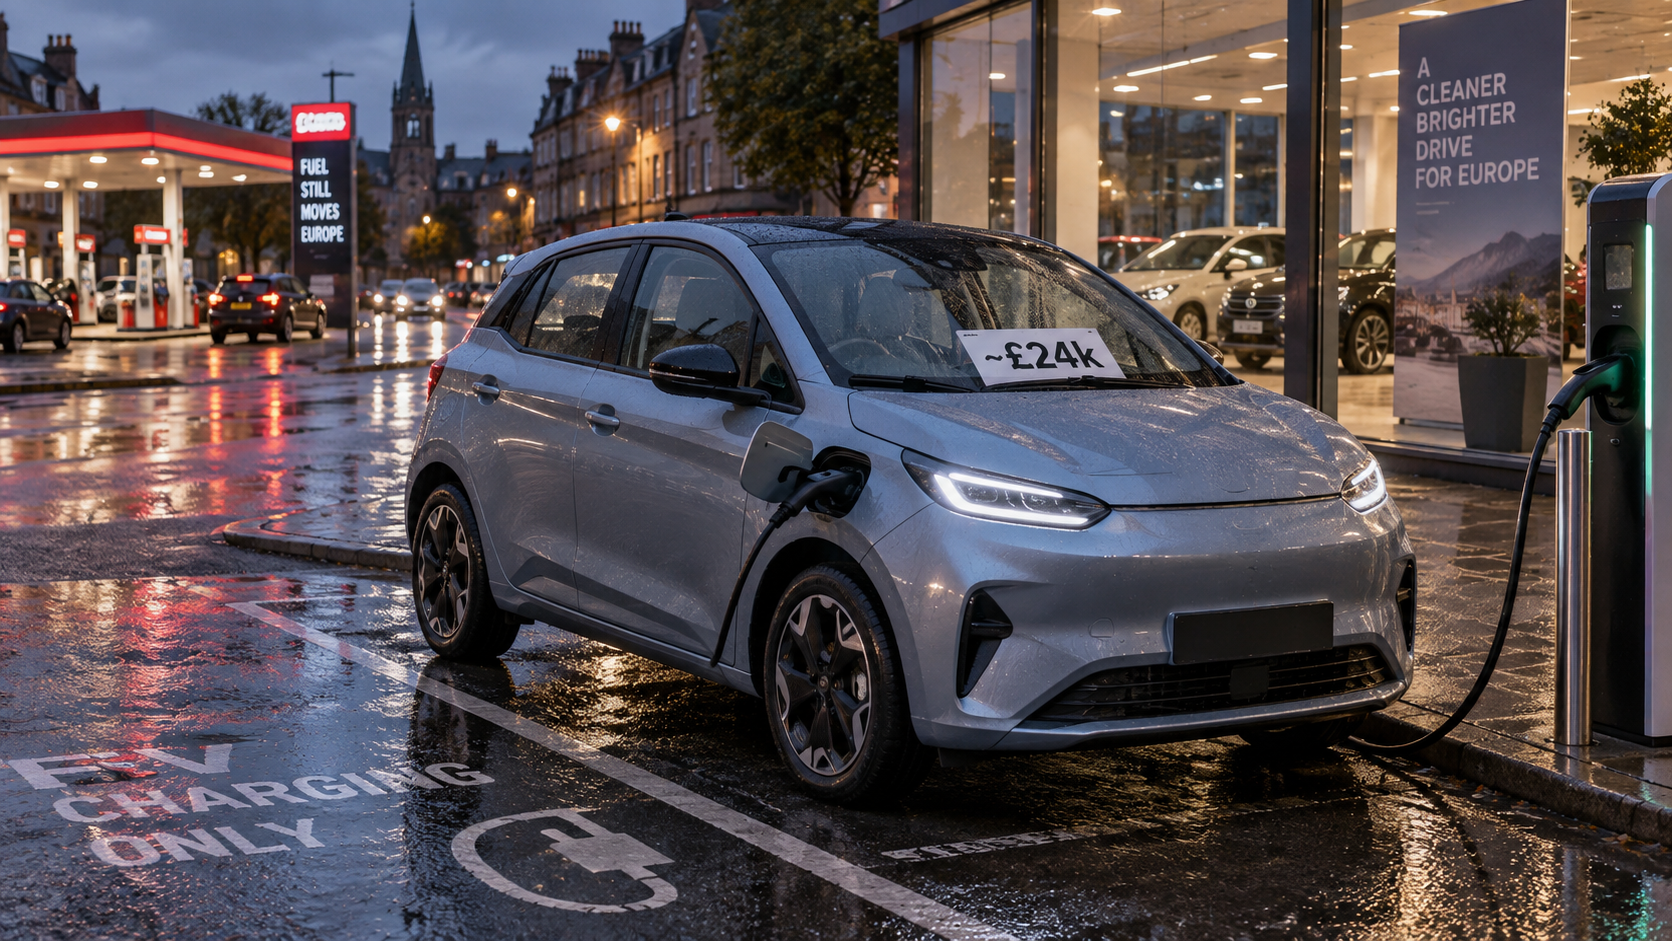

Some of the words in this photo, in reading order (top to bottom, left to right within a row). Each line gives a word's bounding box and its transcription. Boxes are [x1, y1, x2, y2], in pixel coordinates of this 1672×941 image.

[1417, 57, 1430, 79] A
[1417, 72, 1506, 106] CLEANER
[1416, 101, 1516, 134] BRIGHTER
[1416, 135, 1473, 161] DRIVE
[300, 157, 329, 176] FUEL
[1416, 166, 1452, 189] FOR
[1458, 157, 1539, 186] EUROPE
[300, 180, 332, 199] STILL
[300, 203, 340, 221] MOVES
[300, 225, 344, 243] EUROPE
[985, 341, 1105, 370] ~£24k
[53, 762, 495, 823] CHARGING
[90, 818, 325, 867] ONLY
